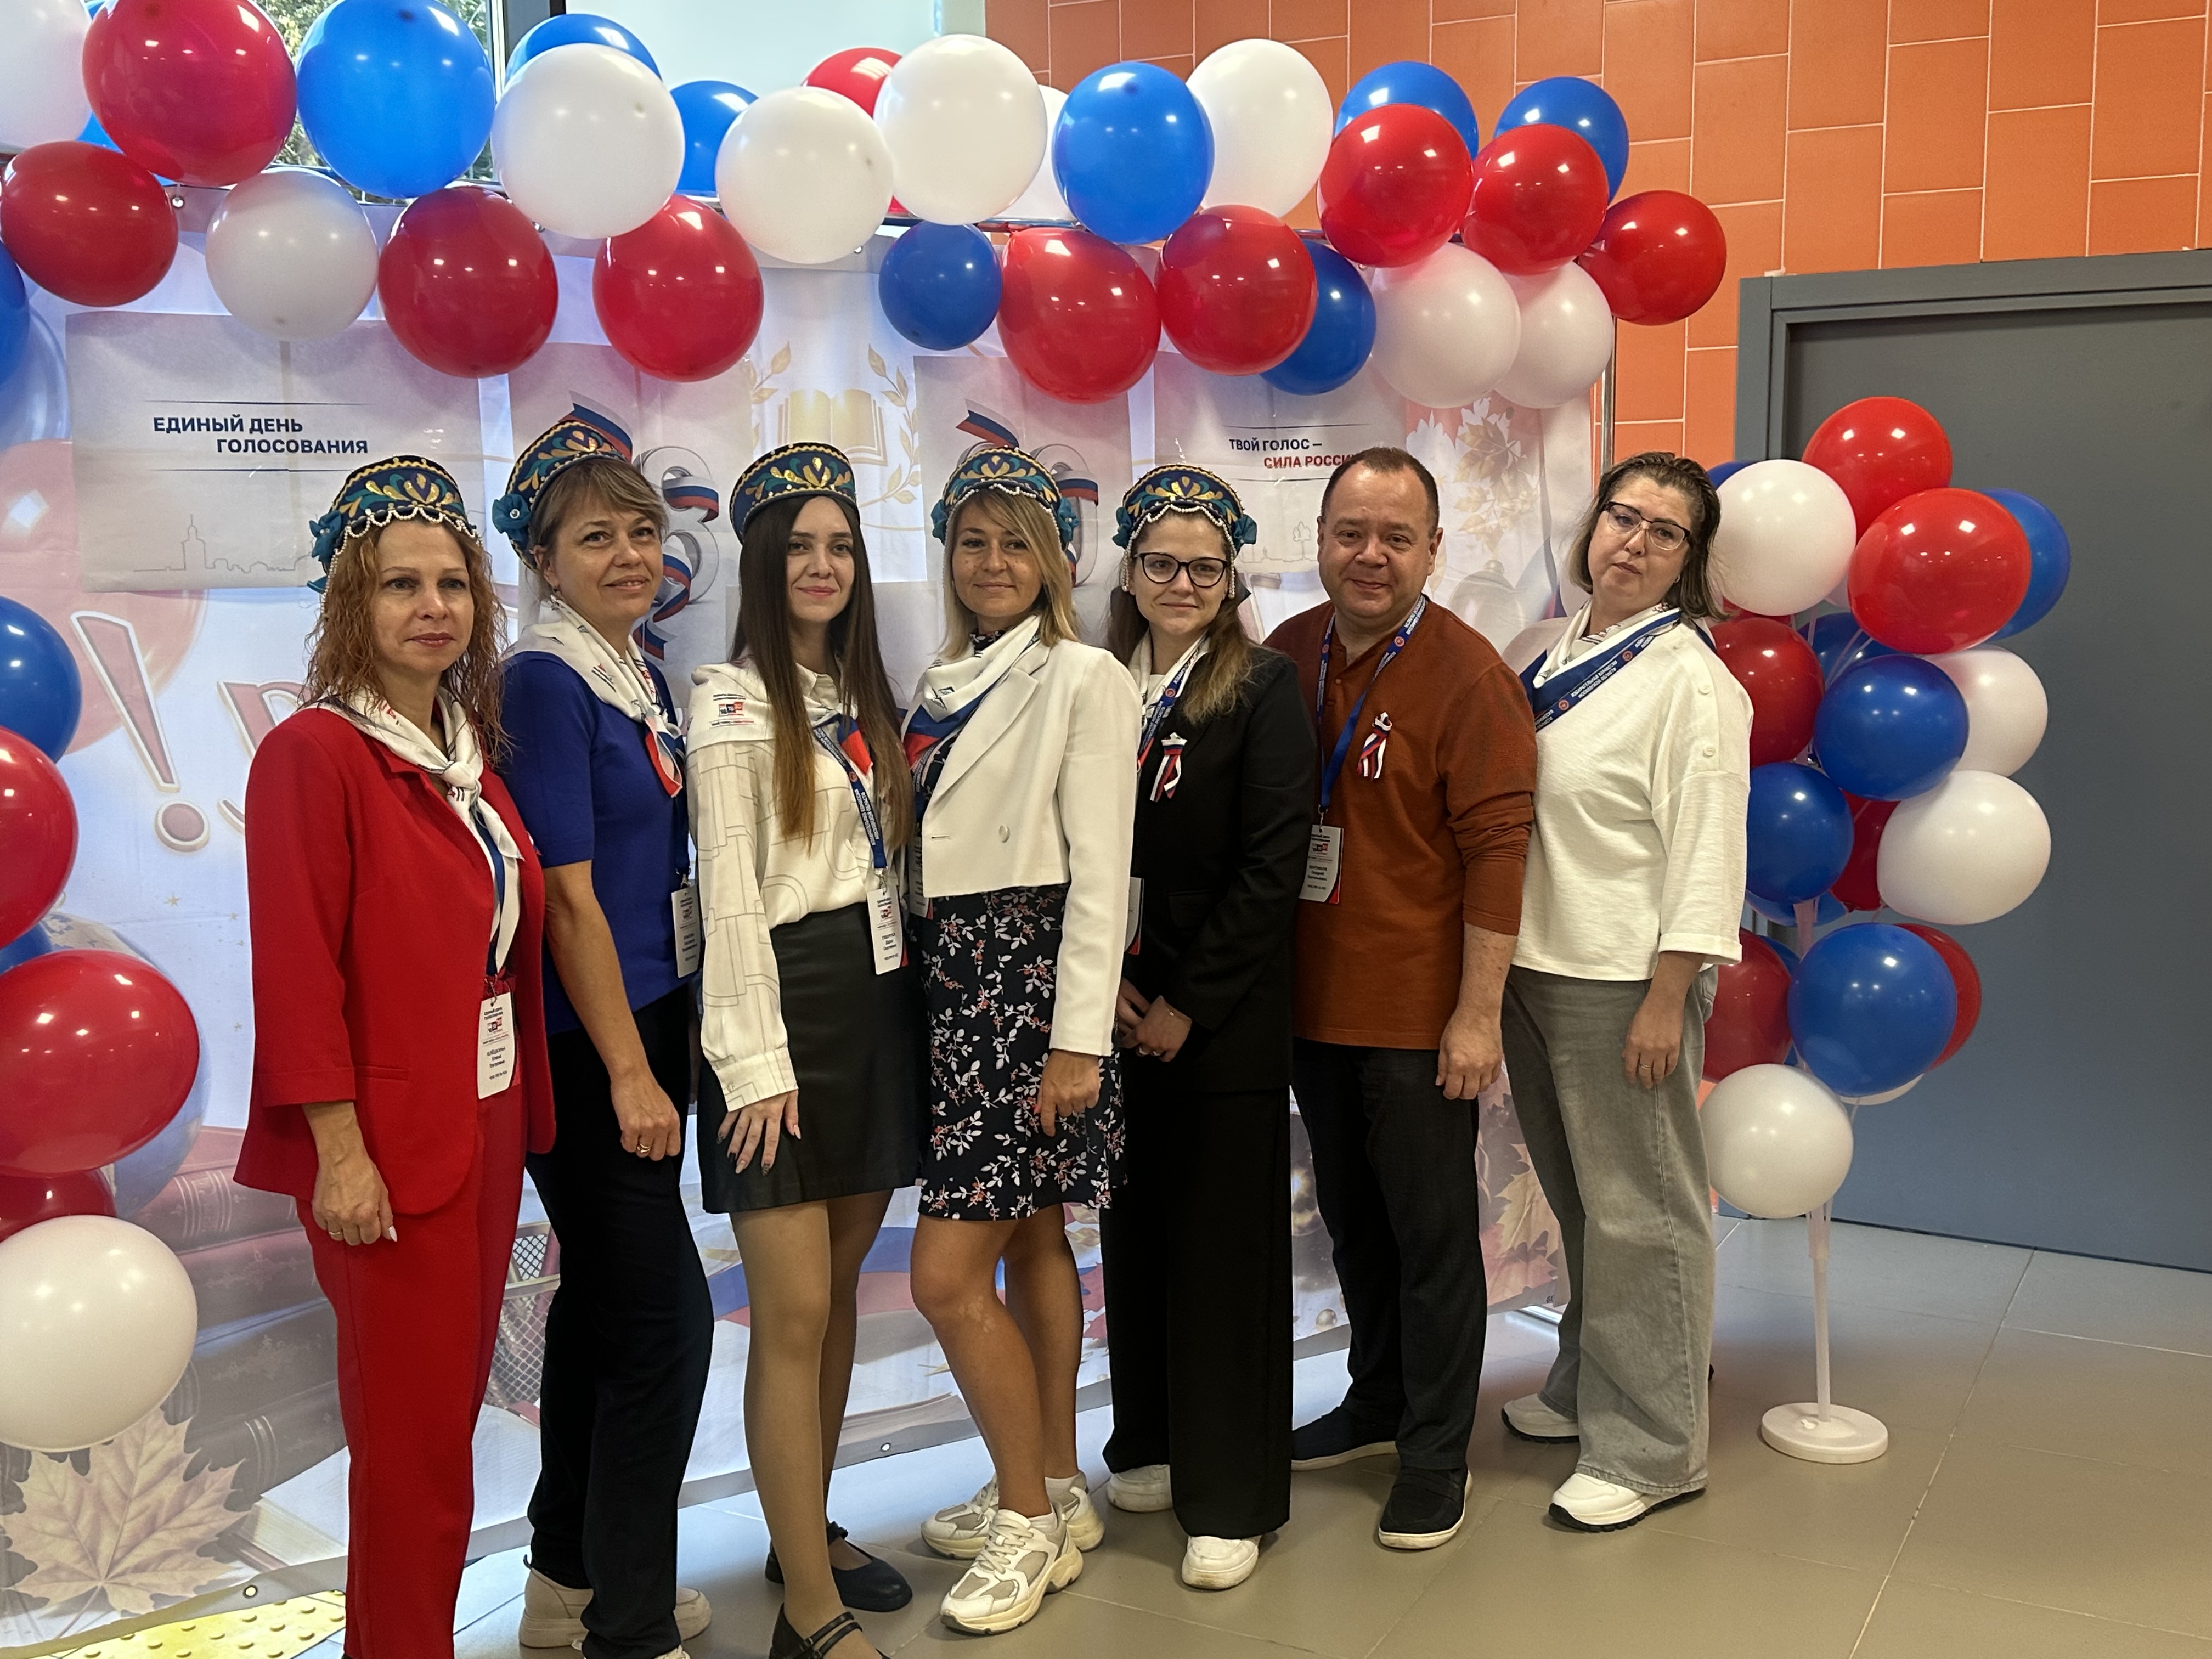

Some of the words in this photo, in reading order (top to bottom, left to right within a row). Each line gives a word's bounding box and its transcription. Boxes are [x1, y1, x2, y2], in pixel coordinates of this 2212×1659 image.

[153, 414, 244, 434] ЕДИНЫЙ
[249, 419, 303, 435] ДЕНЬ
[217, 439, 369, 454] ГОЛОСОВАНИЯ
[1229, 437, 1260, 452] ТВОЙ
[1263, 438, 1310, 452] ГОЛОС
[1263, 456, 1302, 469] СИЛА
[1305, 454, 1356, 467] РОССИ
